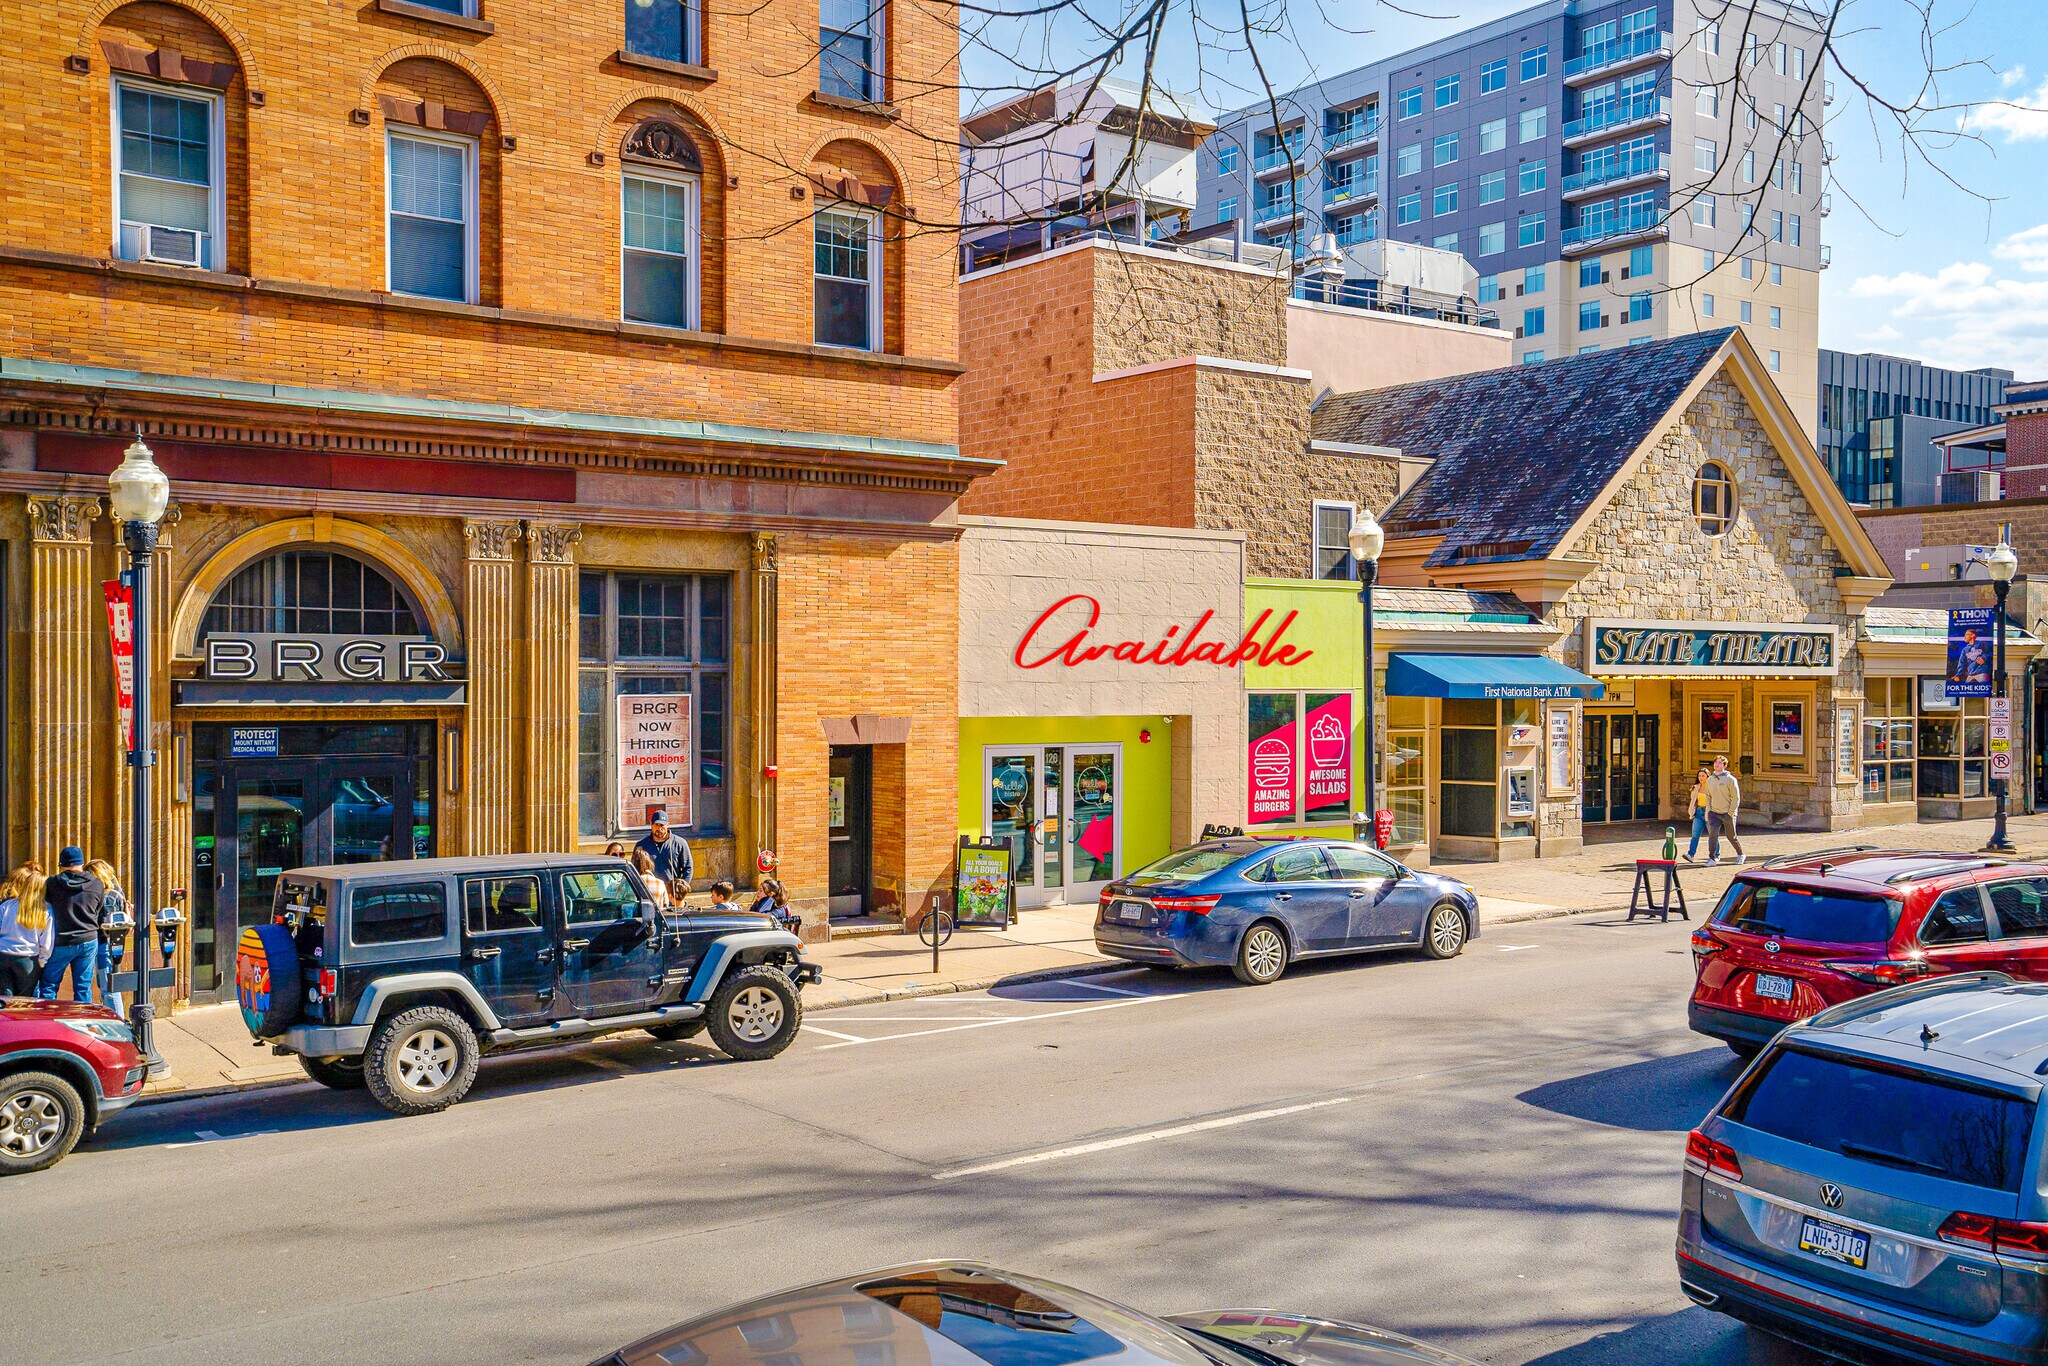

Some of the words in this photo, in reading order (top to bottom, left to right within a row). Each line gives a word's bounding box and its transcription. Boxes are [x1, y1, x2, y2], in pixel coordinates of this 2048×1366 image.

[1959, 609, 1990, 619] THON
[1598, 629, 1696, 663] STATE
[1708, 632, 1830, 667] THEATRE
[206, 638, 450, 681] BRGR
[1484, 686, 1500, 697] First
[1501, 686, 1532, 697] National
[1533, 686, 1552, 697] Bank
[1554, 686, 1571, 697] ATM
[1608, 692, 1621, 701] 7PM
[632, 703, 678, 714] BRGR
[638, 722, 672, 732] NOW
[233, 730, 277, 740] PROTECT
[630, 739, 680, 749] HIRING
[625, 755, 638, 764] all
[639, 754, 685, 766] positions
[633, 770, 678, 780] APPLY
[1309, 769, 1347, 780] AWESOME
[630, 787, 681, 798] WITHIN
[1309, 781, 1347, 795] SALADS
[1254, 789, 1290, 801] AMAZING
[1254, 802, 1290, 812] BURGERS
[980, 866, 1003, 874] BOWL!
[1707, 1188, 1717, 1196] SE
[1718, 1192, 1728, 1200] V6
[1819, 1222, 1853, 1236] PENNSYLVANIA
